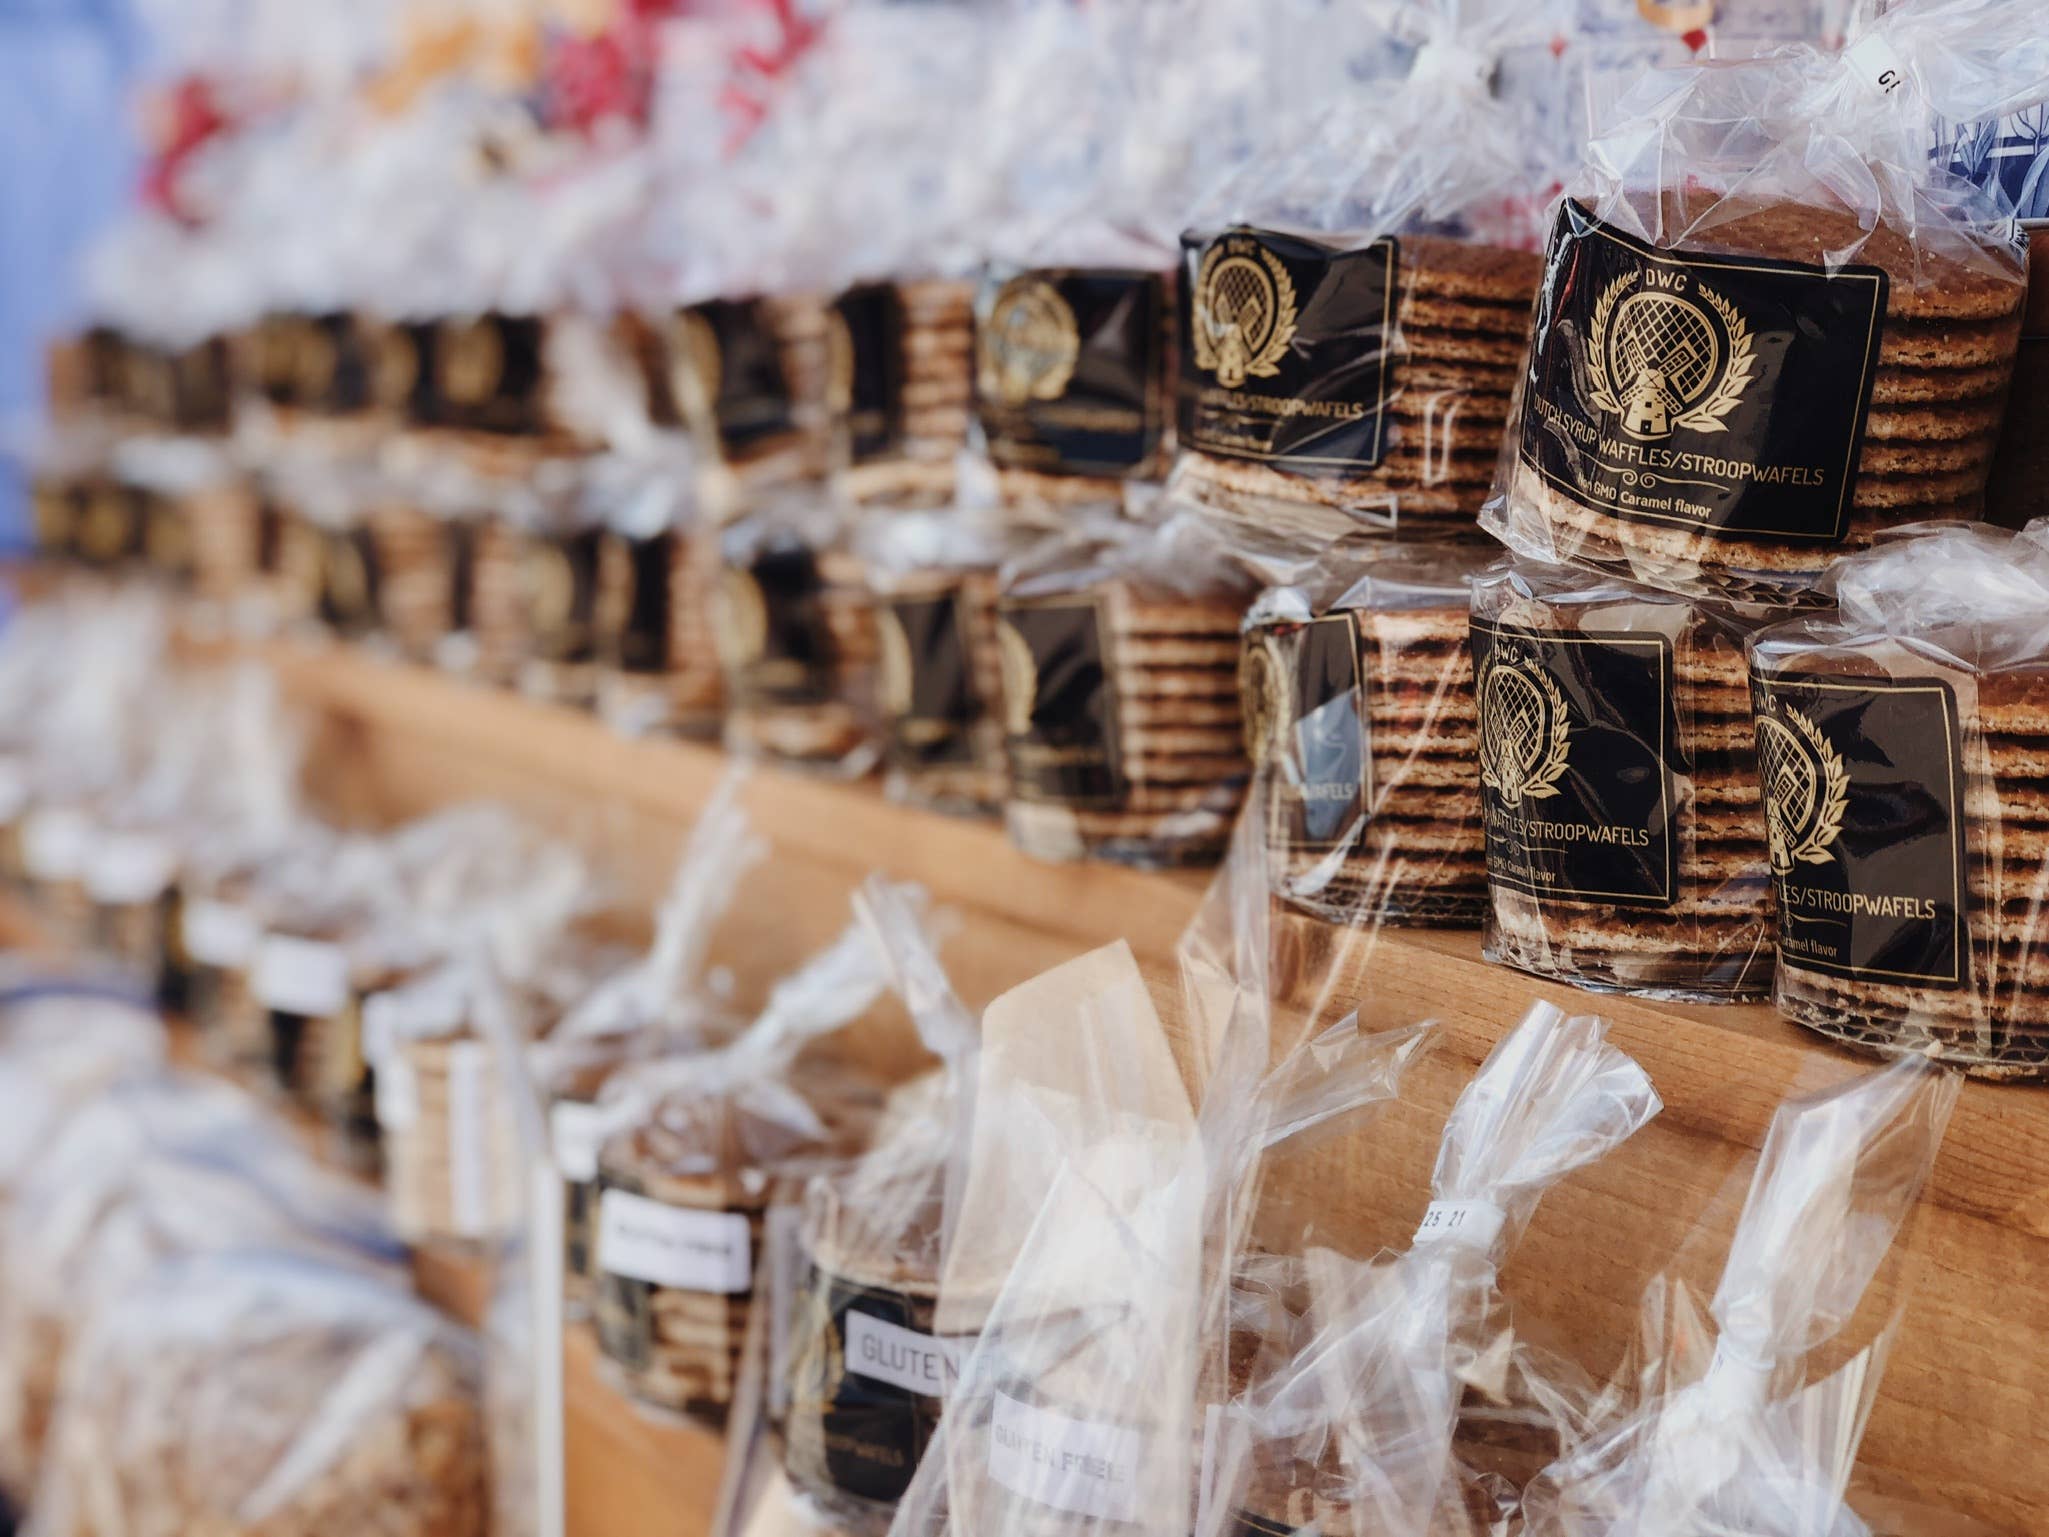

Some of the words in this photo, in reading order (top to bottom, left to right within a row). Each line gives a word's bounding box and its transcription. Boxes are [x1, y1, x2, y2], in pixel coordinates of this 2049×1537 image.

[1645, 267, 1688, 292] DWC
[1534, 392, 1562, 427] DUTCH
[1563, 413, 1597, 445] SYRUP
[1599, 435, 1825, 486] WAFFLES/STROOPWAFELS
[1594, 480, 1617, 501] GMO
[1620, 490, 1672, 511] Caramel
[1674, 498, 1713, 519] flavor
[1495, 643, 1518, 664] DWC
[1811, 939, 1838, 958] flavor
[1424, 1211, 1442, 1227] 25
[1448, 1210, 1466, 1227] 21
[862, 1333, 961, 1381] GLUTEN
